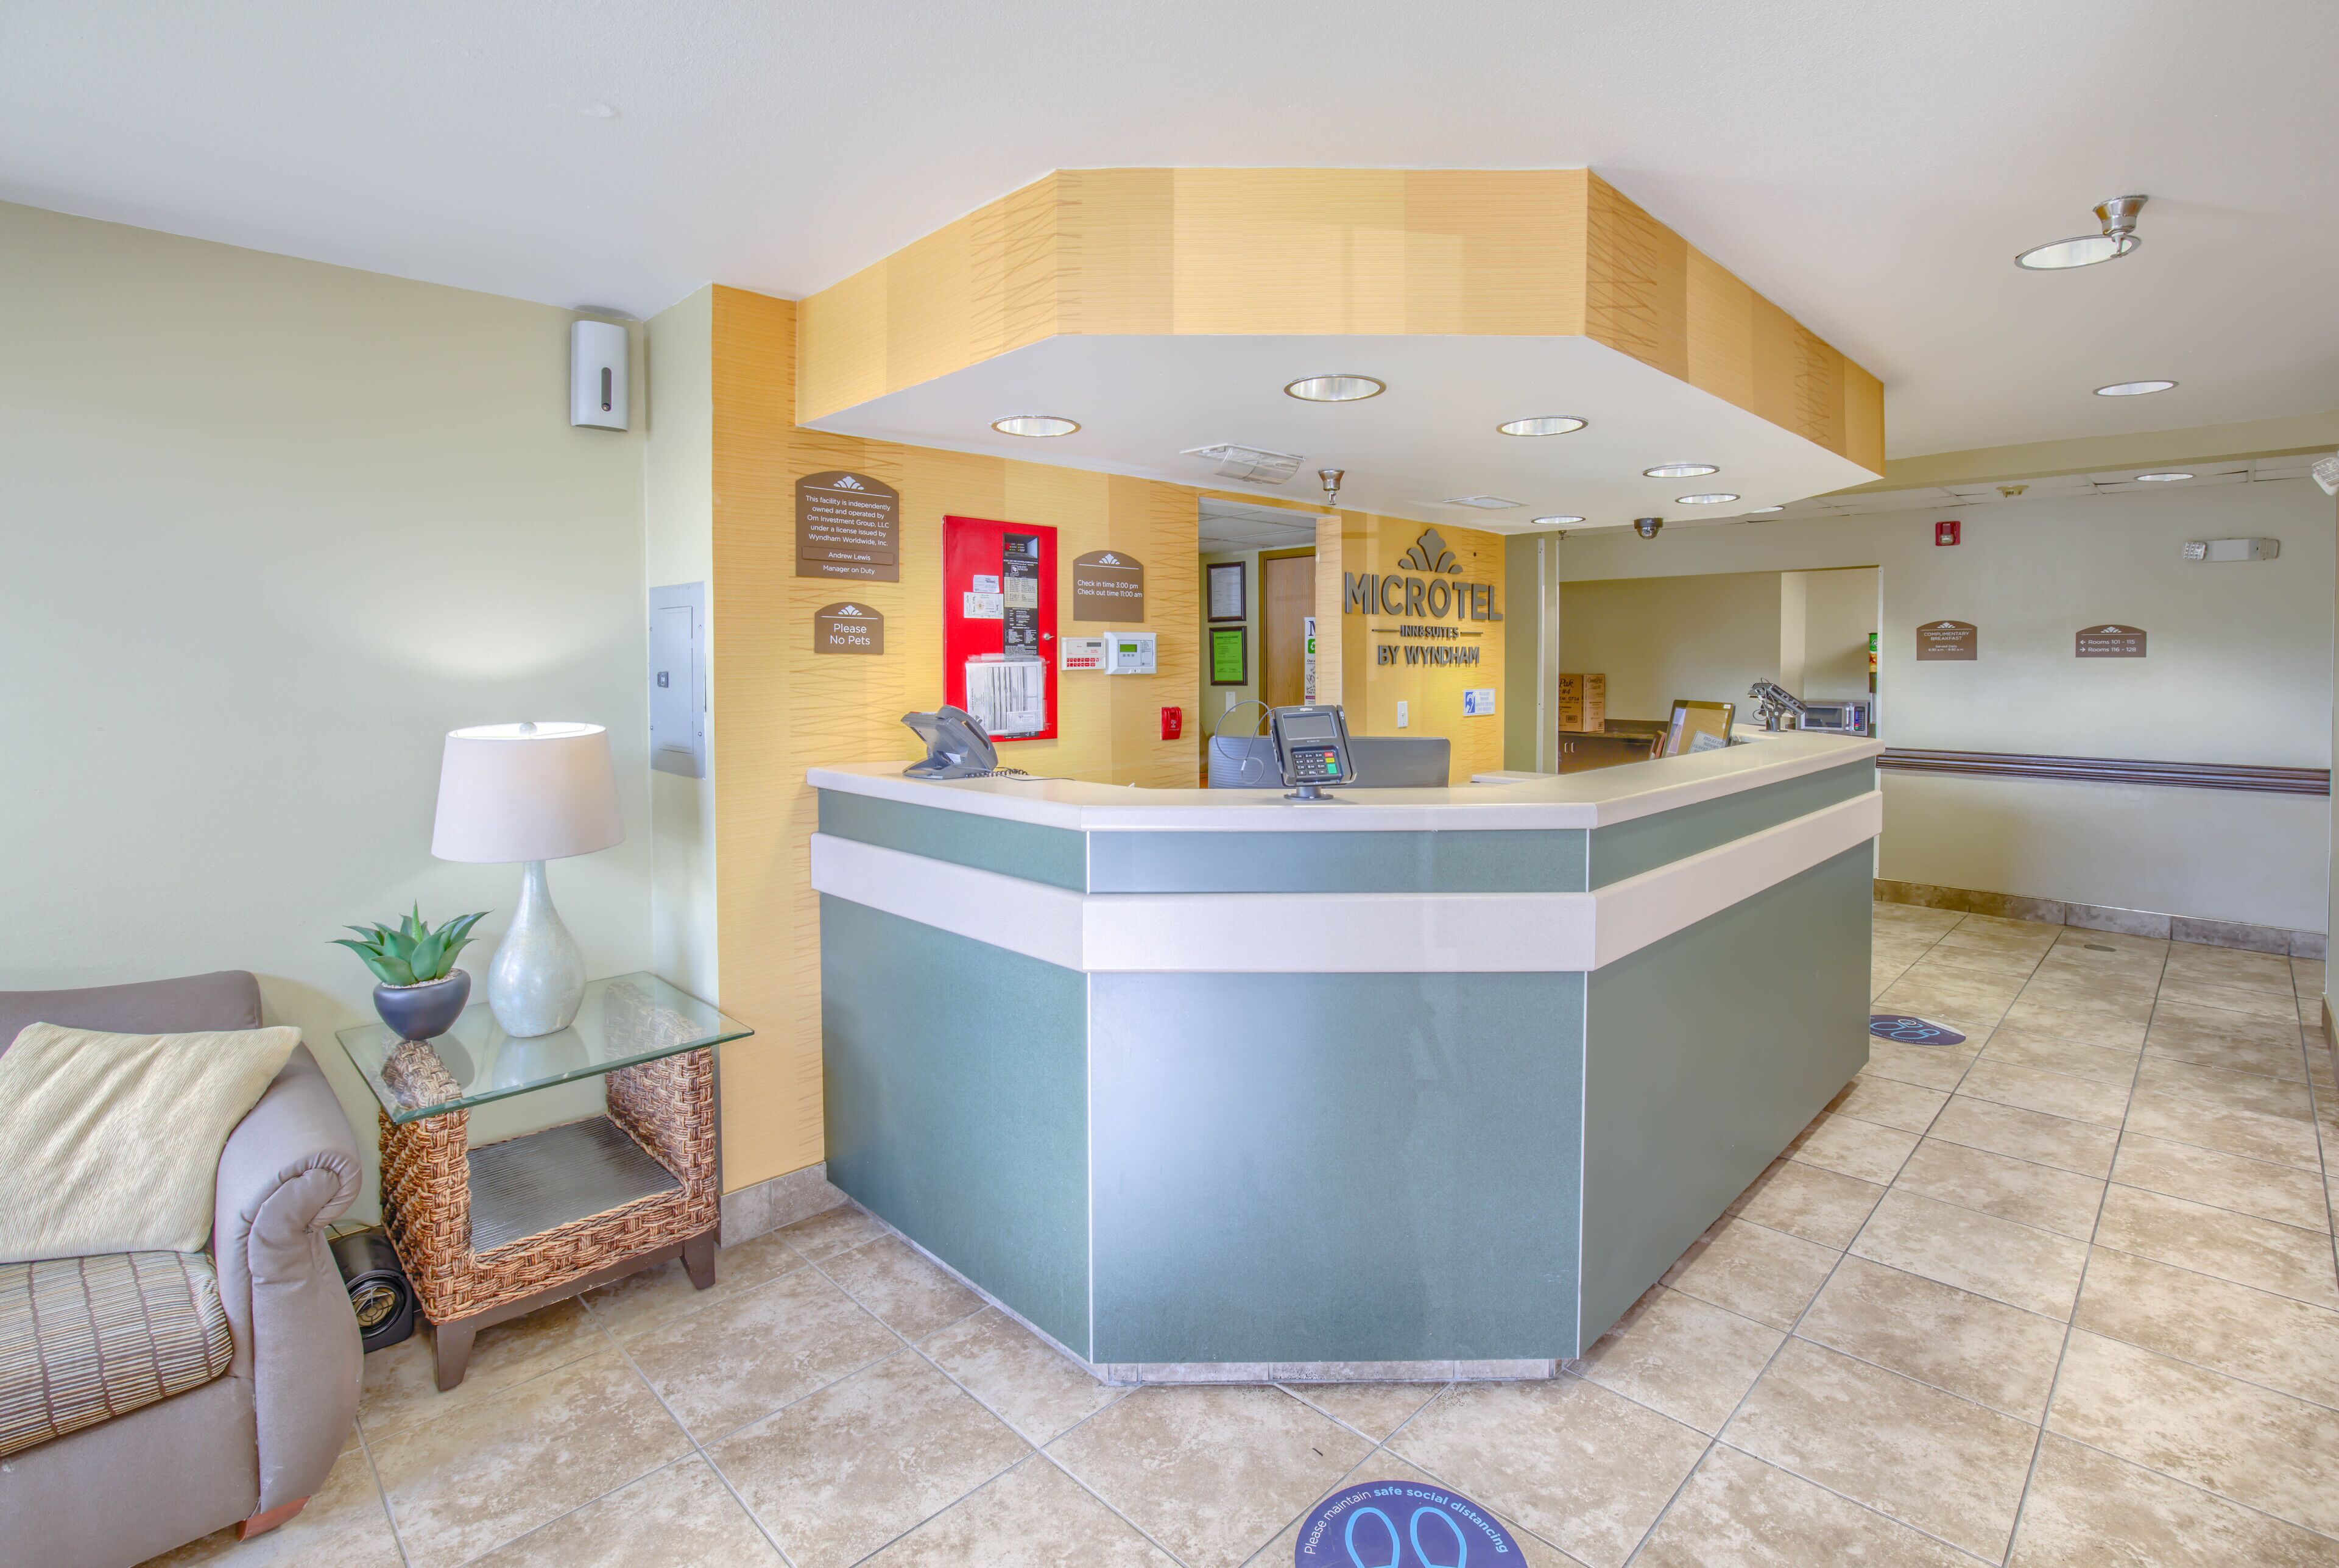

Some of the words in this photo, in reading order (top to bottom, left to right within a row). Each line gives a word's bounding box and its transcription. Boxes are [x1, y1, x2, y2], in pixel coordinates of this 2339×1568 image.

[820, 497, 841, 506] facility
[848, 500, 890, 511] independently
[820, 516, 855, 524] Investment
[842, 537, 877, 546] Worldwide,
[1345, 572, 1503, 621] MICROTEL
[834, 623, 867, 634] Please
[830, 635, 845, 645] No
[848, 635, 870, 646] Pets
[1378, 645, 1400, 665] BY
[1405, 645, 1480, 665] WYNDHAM
[1304, 1519, 1327, 1555] Please
[1324, 1490, 1372, 1522] maintain
[1374, 1486, 1403, 1497] safe
[1406, 1489, 1449, 1505] social
[1450, 1500, 1509, 1554] distancing
